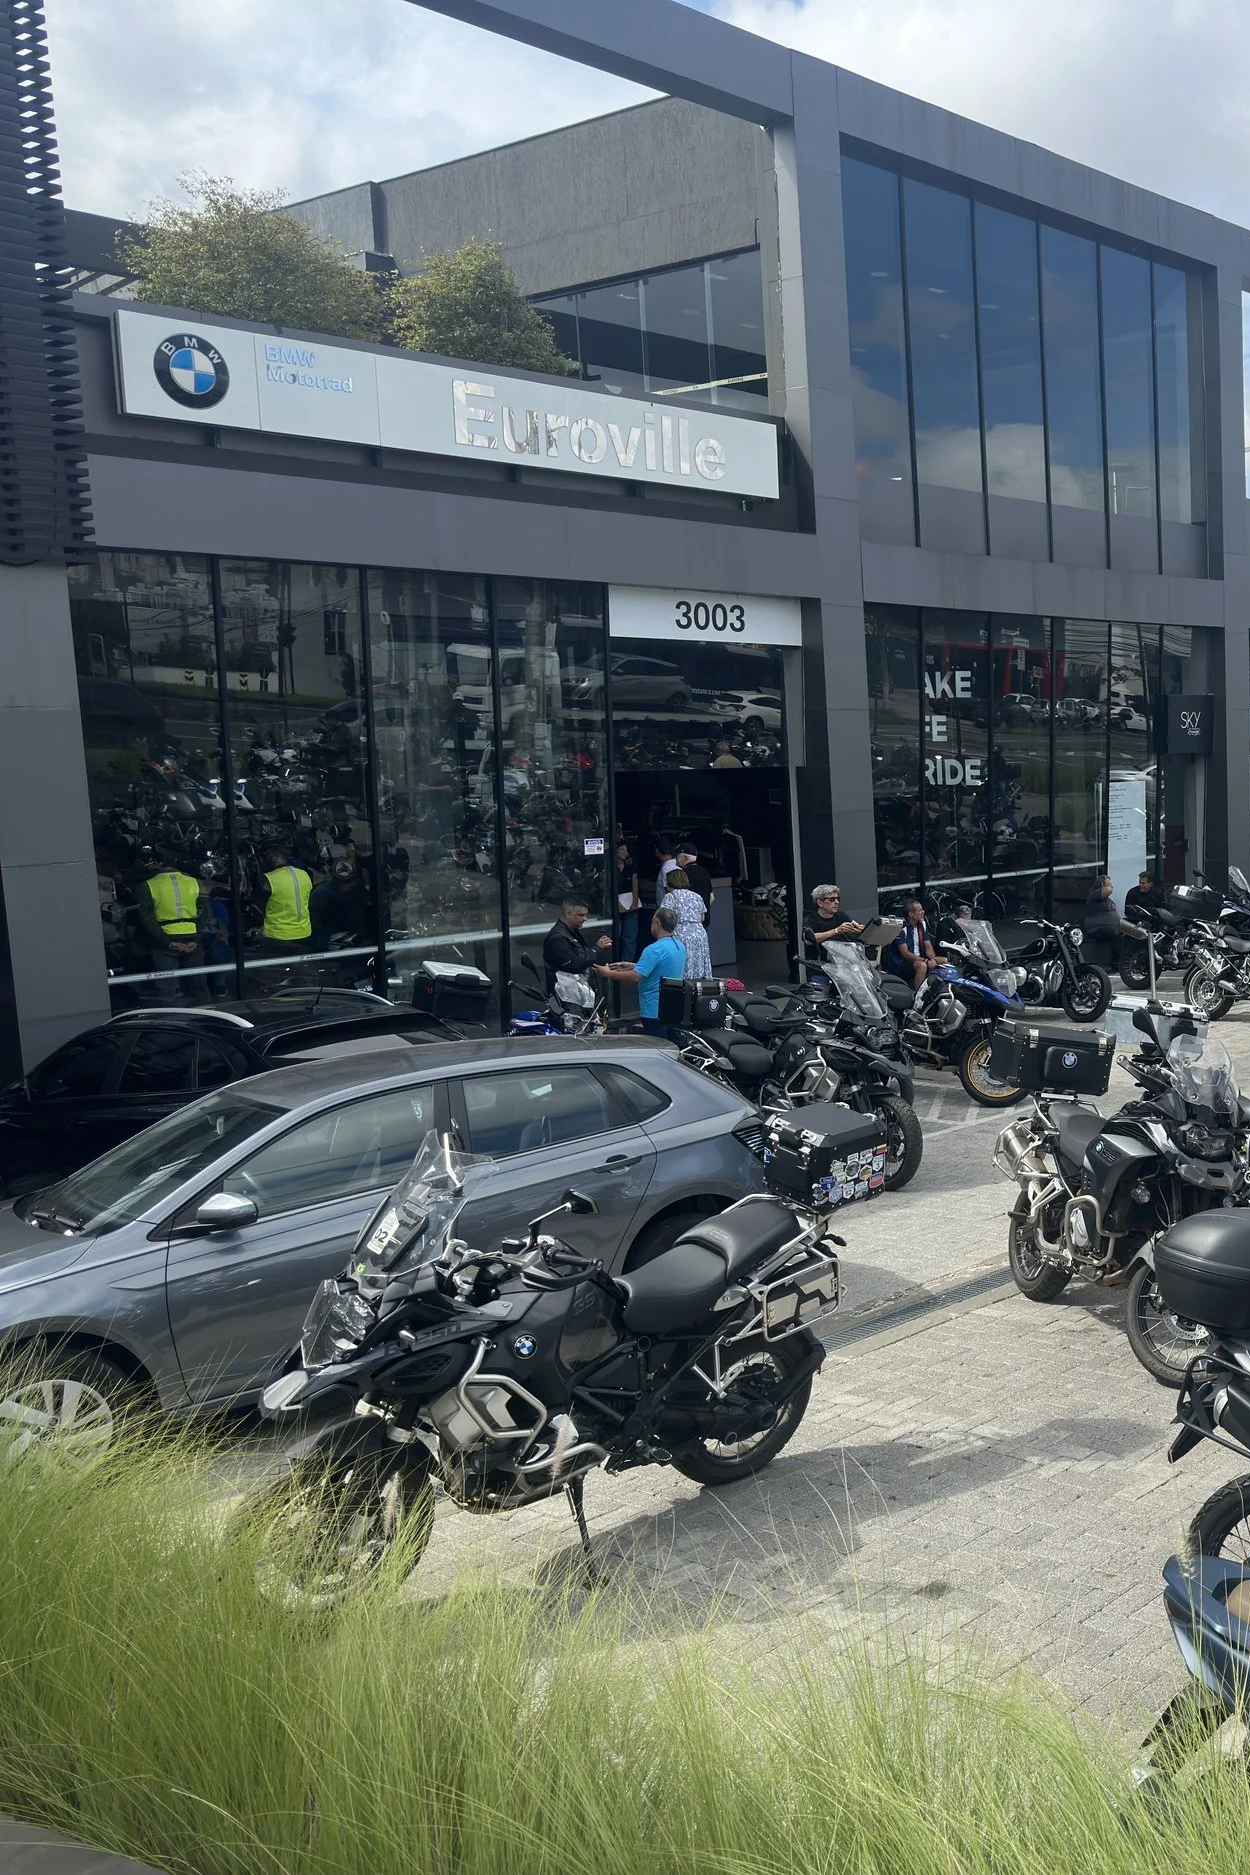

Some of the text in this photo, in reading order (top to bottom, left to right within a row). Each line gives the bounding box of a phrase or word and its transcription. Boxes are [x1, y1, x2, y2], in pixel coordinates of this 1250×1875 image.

[265, 343, 316, 368] BMW
[266, 364, 354, 394] Motorrad
[452, 379, 726, 481] Euroville
[675, 601, 745, 632] 3003
[1180, 711, 1201, 729] SKY
